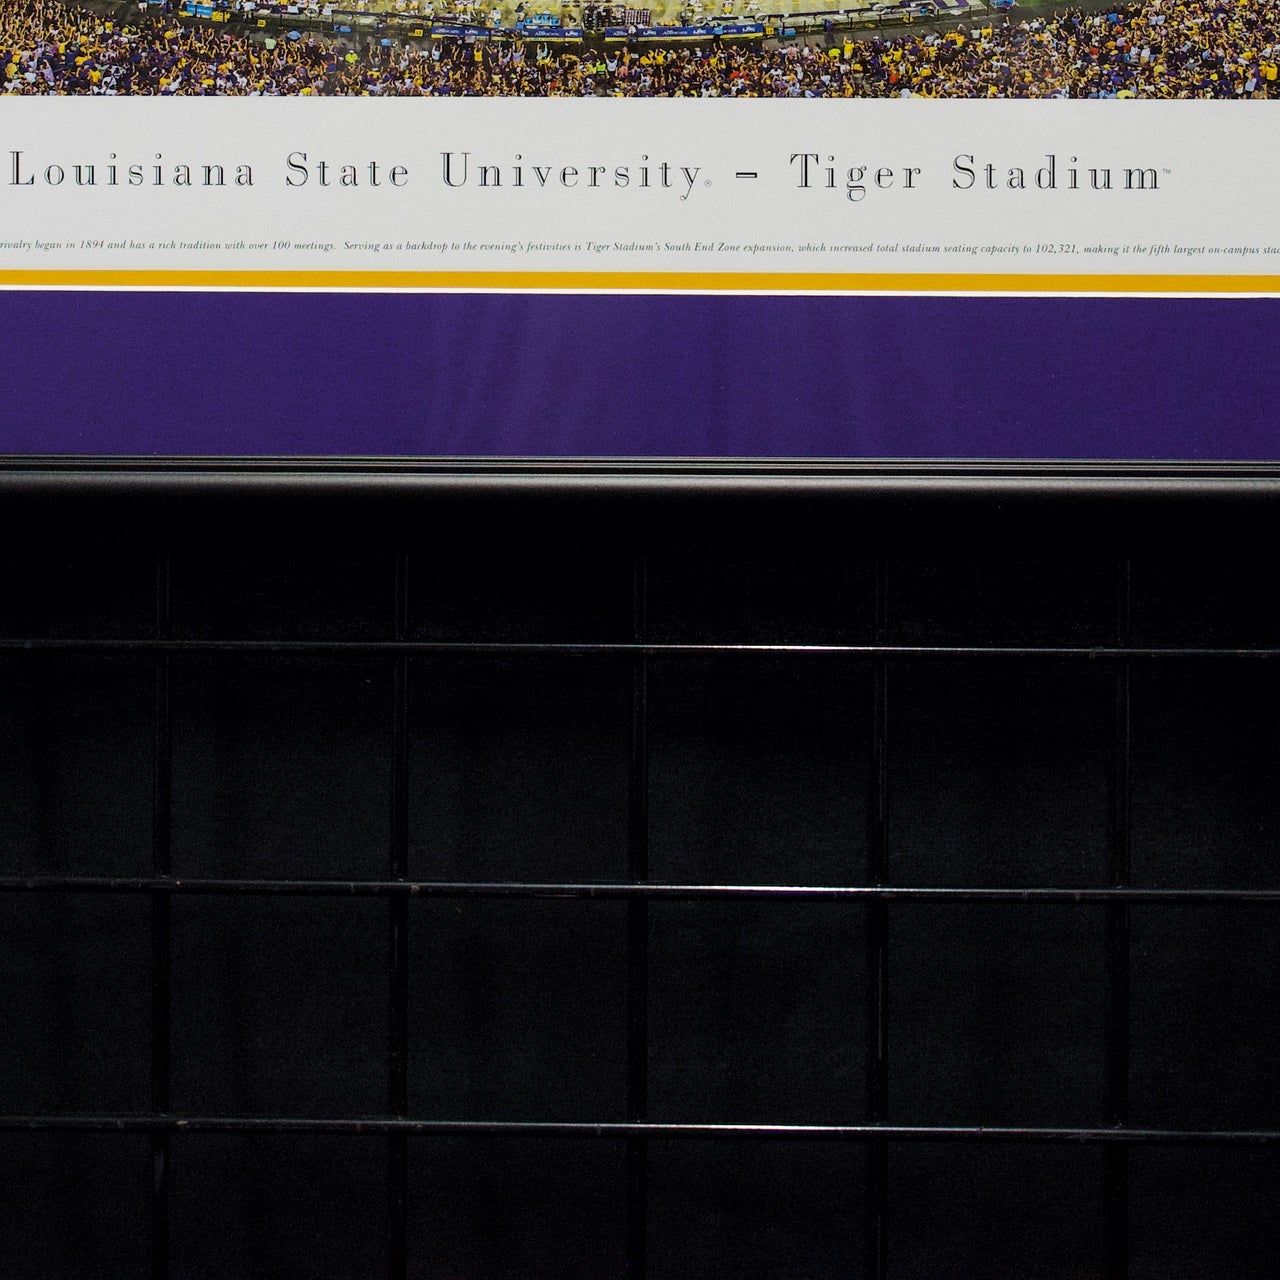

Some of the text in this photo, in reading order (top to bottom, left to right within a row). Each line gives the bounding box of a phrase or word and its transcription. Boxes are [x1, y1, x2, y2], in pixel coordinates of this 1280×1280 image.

[8, 150, 255, 187] Louisiana
[285, 151, 409, 187] State
[789, 153, 922, 202] Tiger
[0, 239, 32, 251] rivalry
[34, 239, 62, 251] began
[65, 240, 76, 249] in
[80, 239, 105, 249] 1894
[107, 240, 127, 249] and
[129, 240, 146, 249] has
[158, 240, 177, 250] rich
[179, 240, 221, 250] tradition
[224, 240, 247, 250] with
[249, 242, 268, 250] over
[273, 240, 292, 250] 100
[343, 241, 381, 253] Serving
[383, 243, 394, 251] as
[396, 243, 403, 251] a
[405, 241, 448, 253] backdrop
[451, 242, 460, 251] to
[463, 241, 477, 251] the
[526, 242, 571, 253] festivities
[574, 243, 582, 251] is
[585, 242, 609, 254] Tiger
[663, 242, 692, 252] South
[694, 242, 715, 252] End
[717, 242, 740, 252] Zone
[798, 243, 827, 252] which
[829, 243, 874, 253] increased
[876, 243, 899, 253] total
[901, 243, 940, 253] stadium
[943, 244, 978, 255] seating
[980, 244, 1020, 255] capacity
[1022, 245, 1032, 253] to
[1083, 244, 1119, 256] making
[1122, 245, 1130, 254] it
[1132, 244, 1147, 254] the
[1149, 244, 1171, 256] fifth
[1173, 244, 1206, 256] largest
[1208, 246, 1260, 256] on-campus
